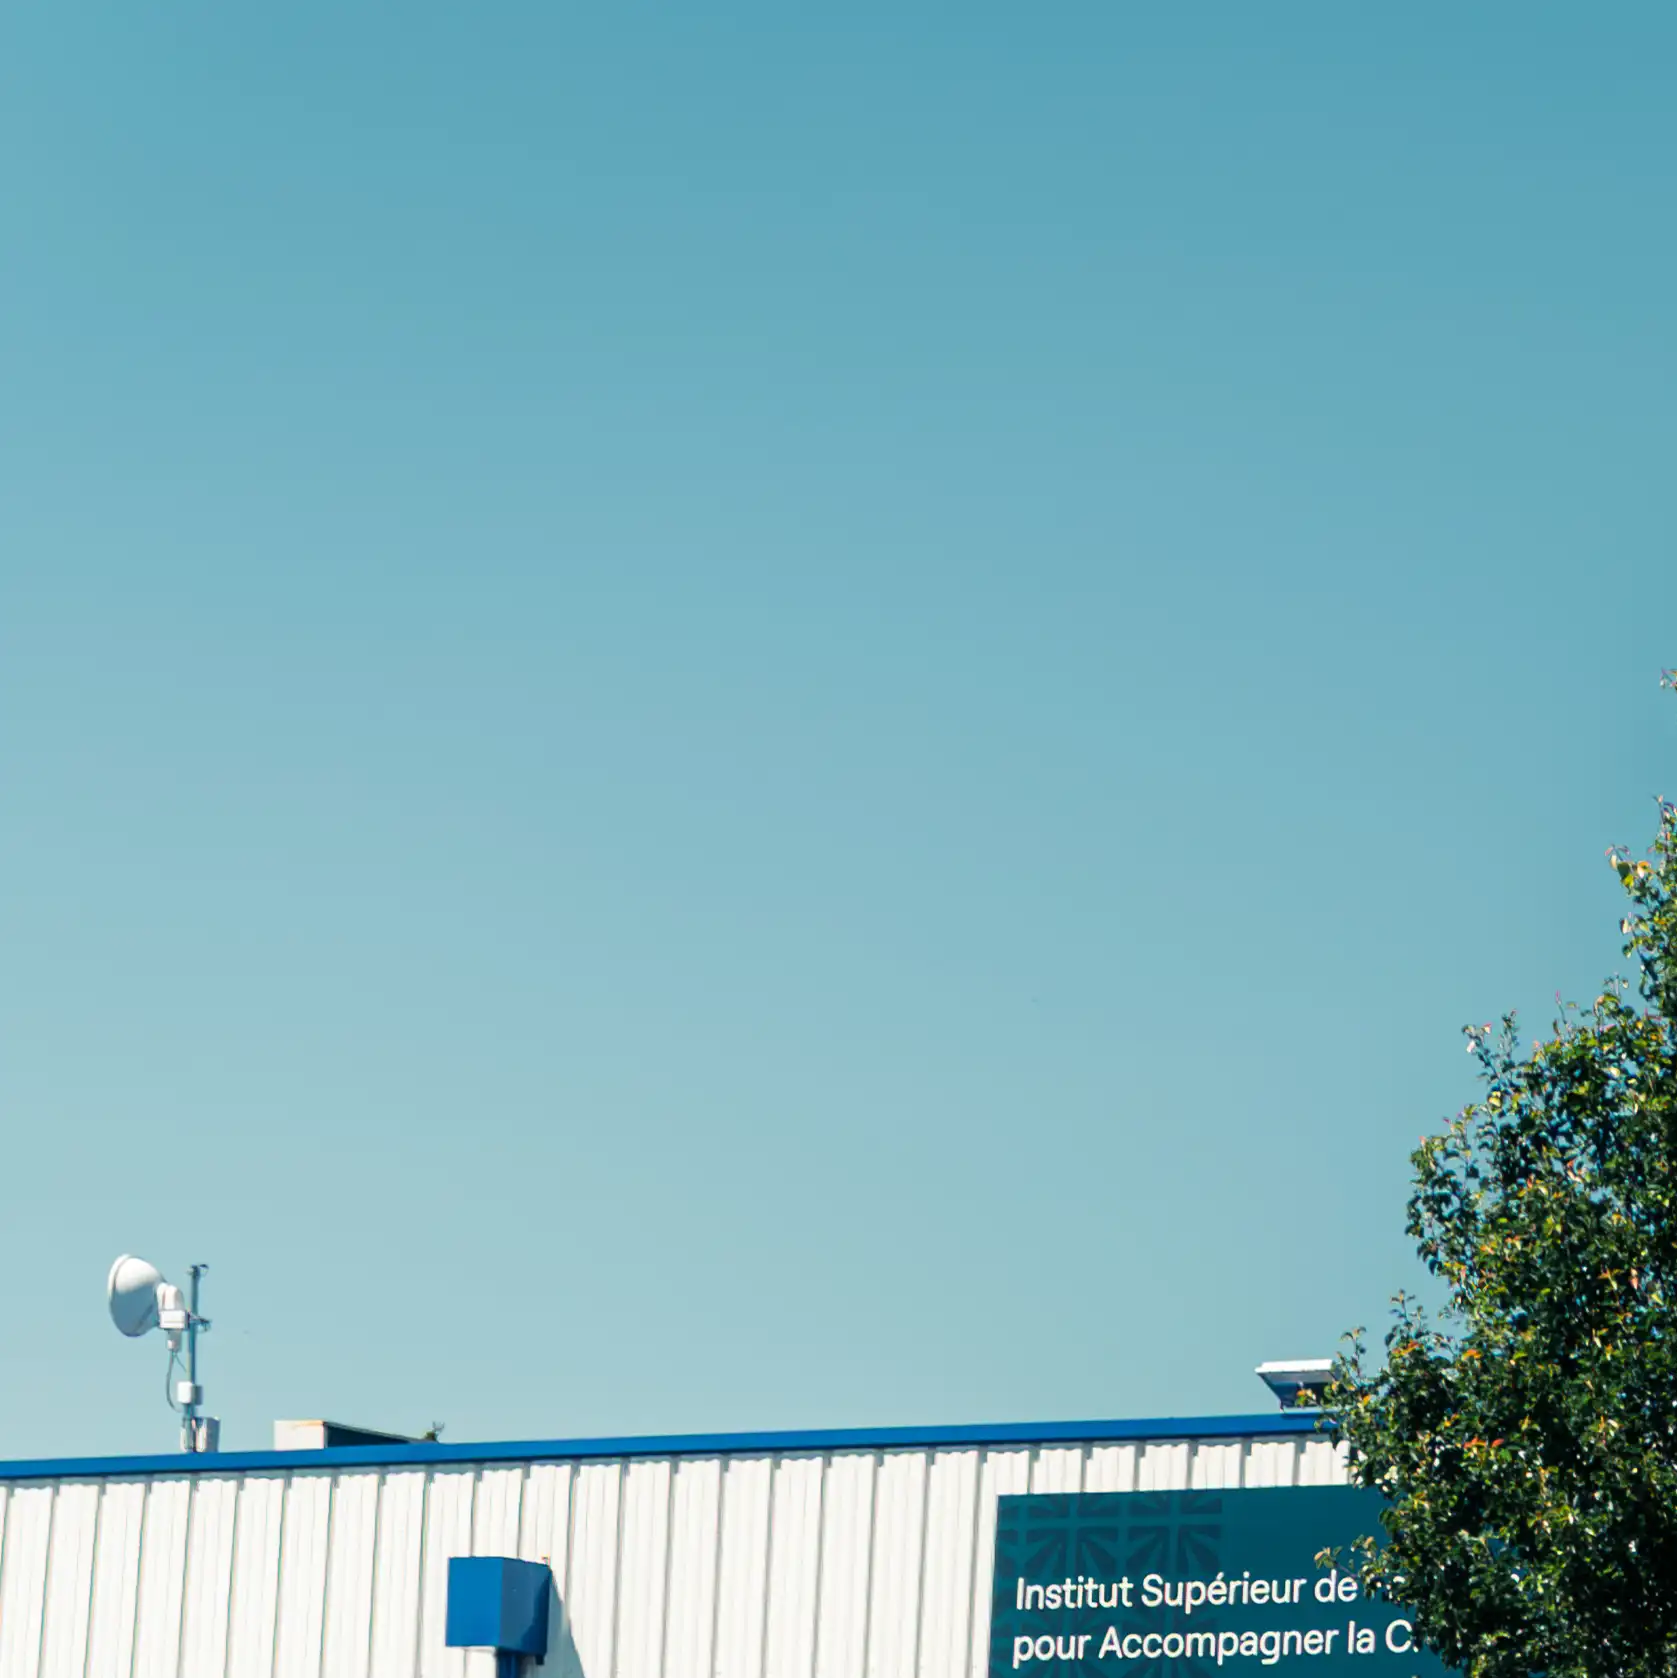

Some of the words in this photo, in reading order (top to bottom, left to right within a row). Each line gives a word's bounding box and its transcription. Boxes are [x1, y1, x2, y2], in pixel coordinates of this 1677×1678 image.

[1016, 1575, 1135, 1611] Institut
[1141, 1570, 1308, 1615] Supérieur
[1314, 1568, 1359, 1603] de
[1012, 1634, 1092, 1670] pour
[1098, 1625, 1340, 1666] Accompagner
[1347, 1620, 1376, 1654] la
[1385, 1618, 1419, 1653] C
